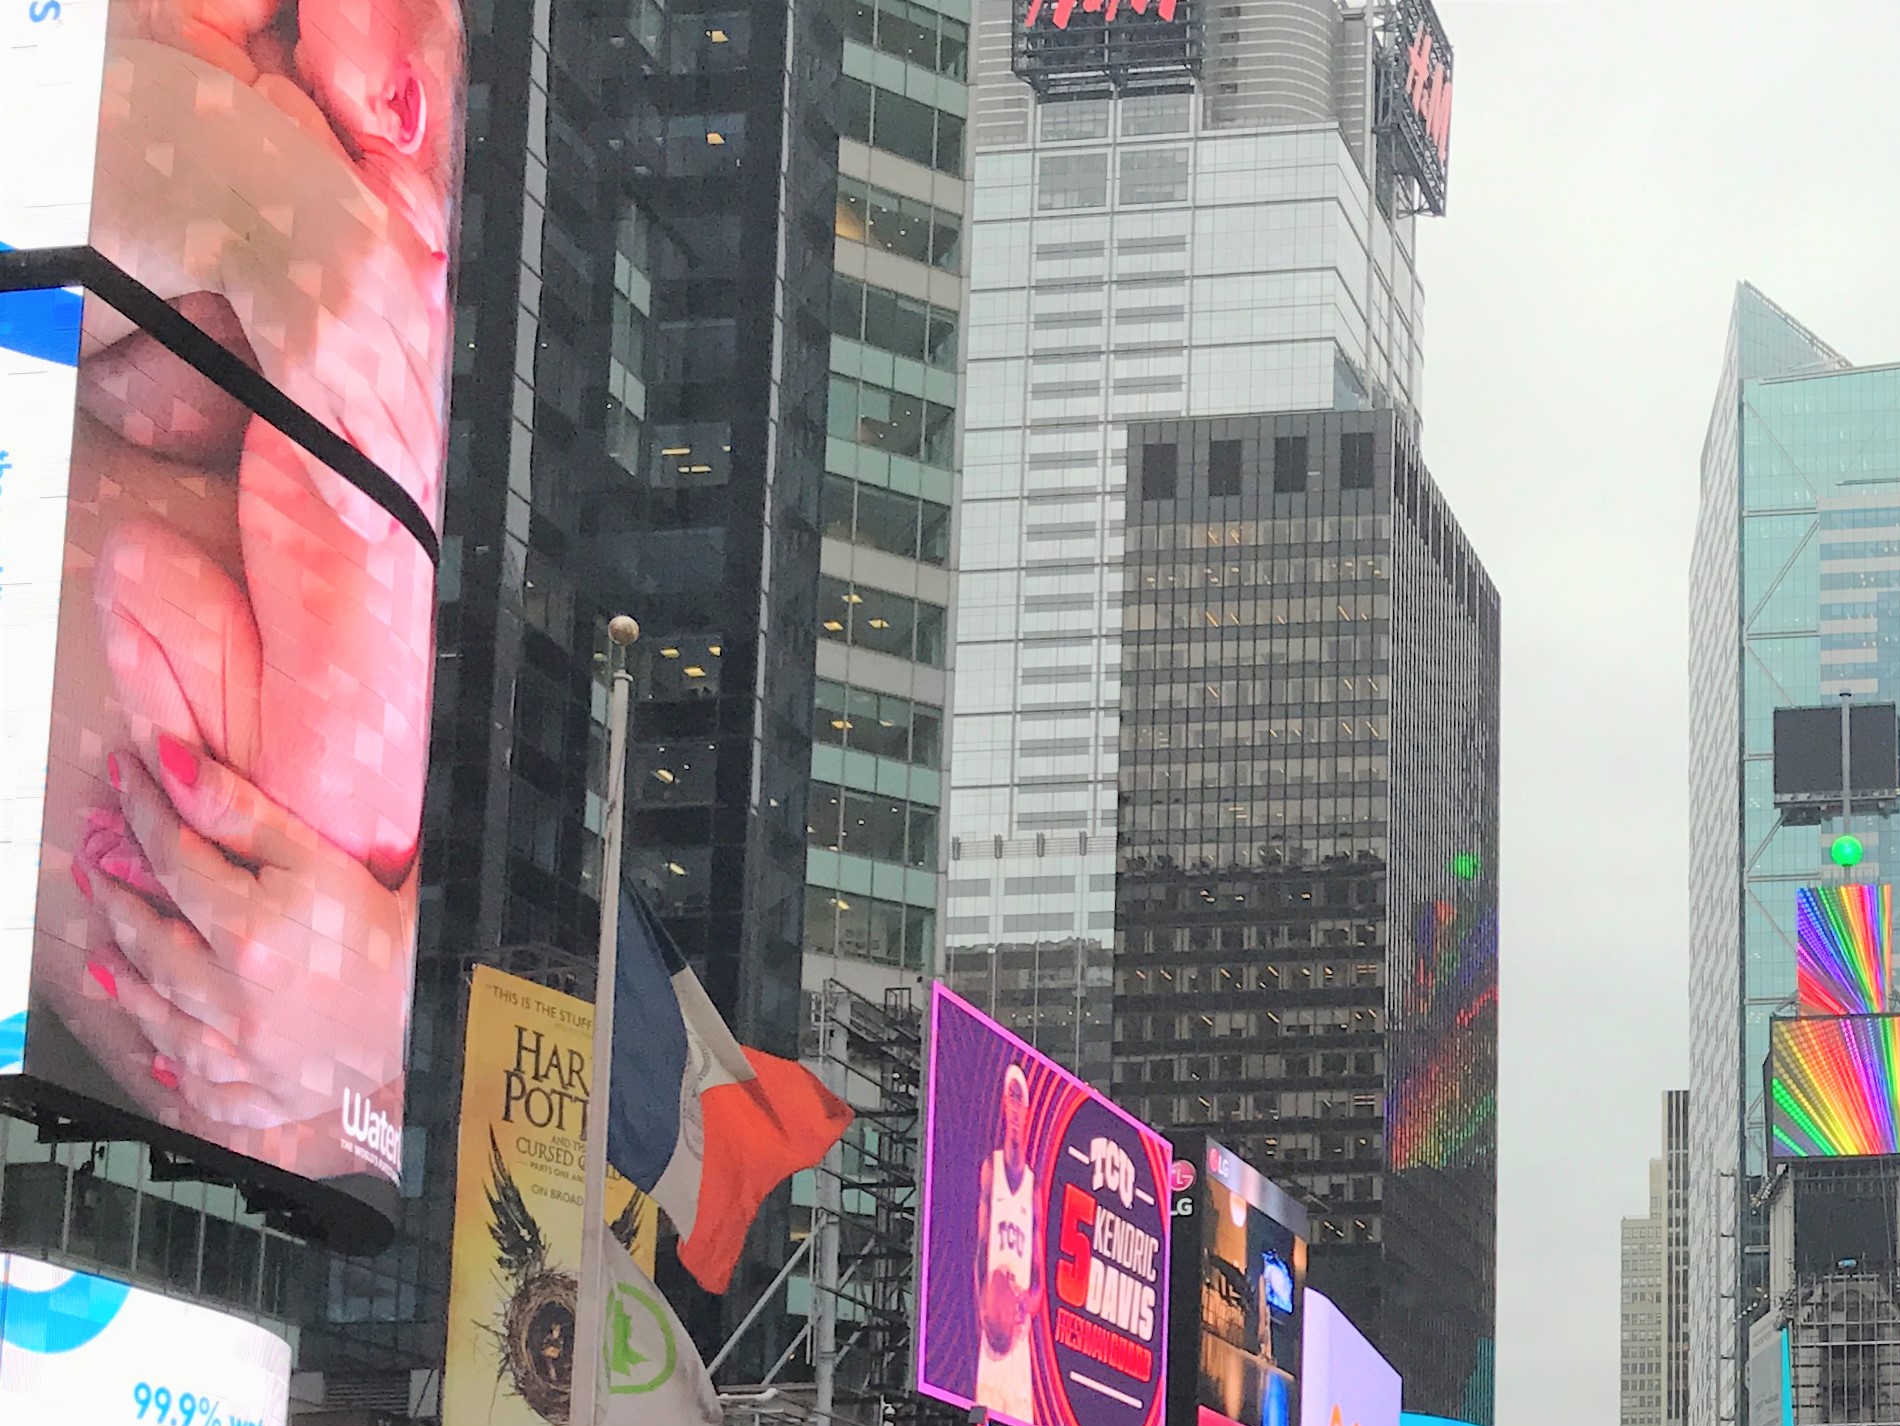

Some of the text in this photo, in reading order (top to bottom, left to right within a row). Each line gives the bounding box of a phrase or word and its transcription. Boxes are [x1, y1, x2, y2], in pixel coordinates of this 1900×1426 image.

[521, 996, 593, 1033] IS THE STUFF
[516, 1136, 574, 1167] CURSED
[1090, 1137, 1136, 1210] TCU
[1218, 1156, 1229, 1178] LG
[1056, 1182, 1159, 1308] 5 KENDRIC
[1085, 1256, 1156, 1342] DAVIS
